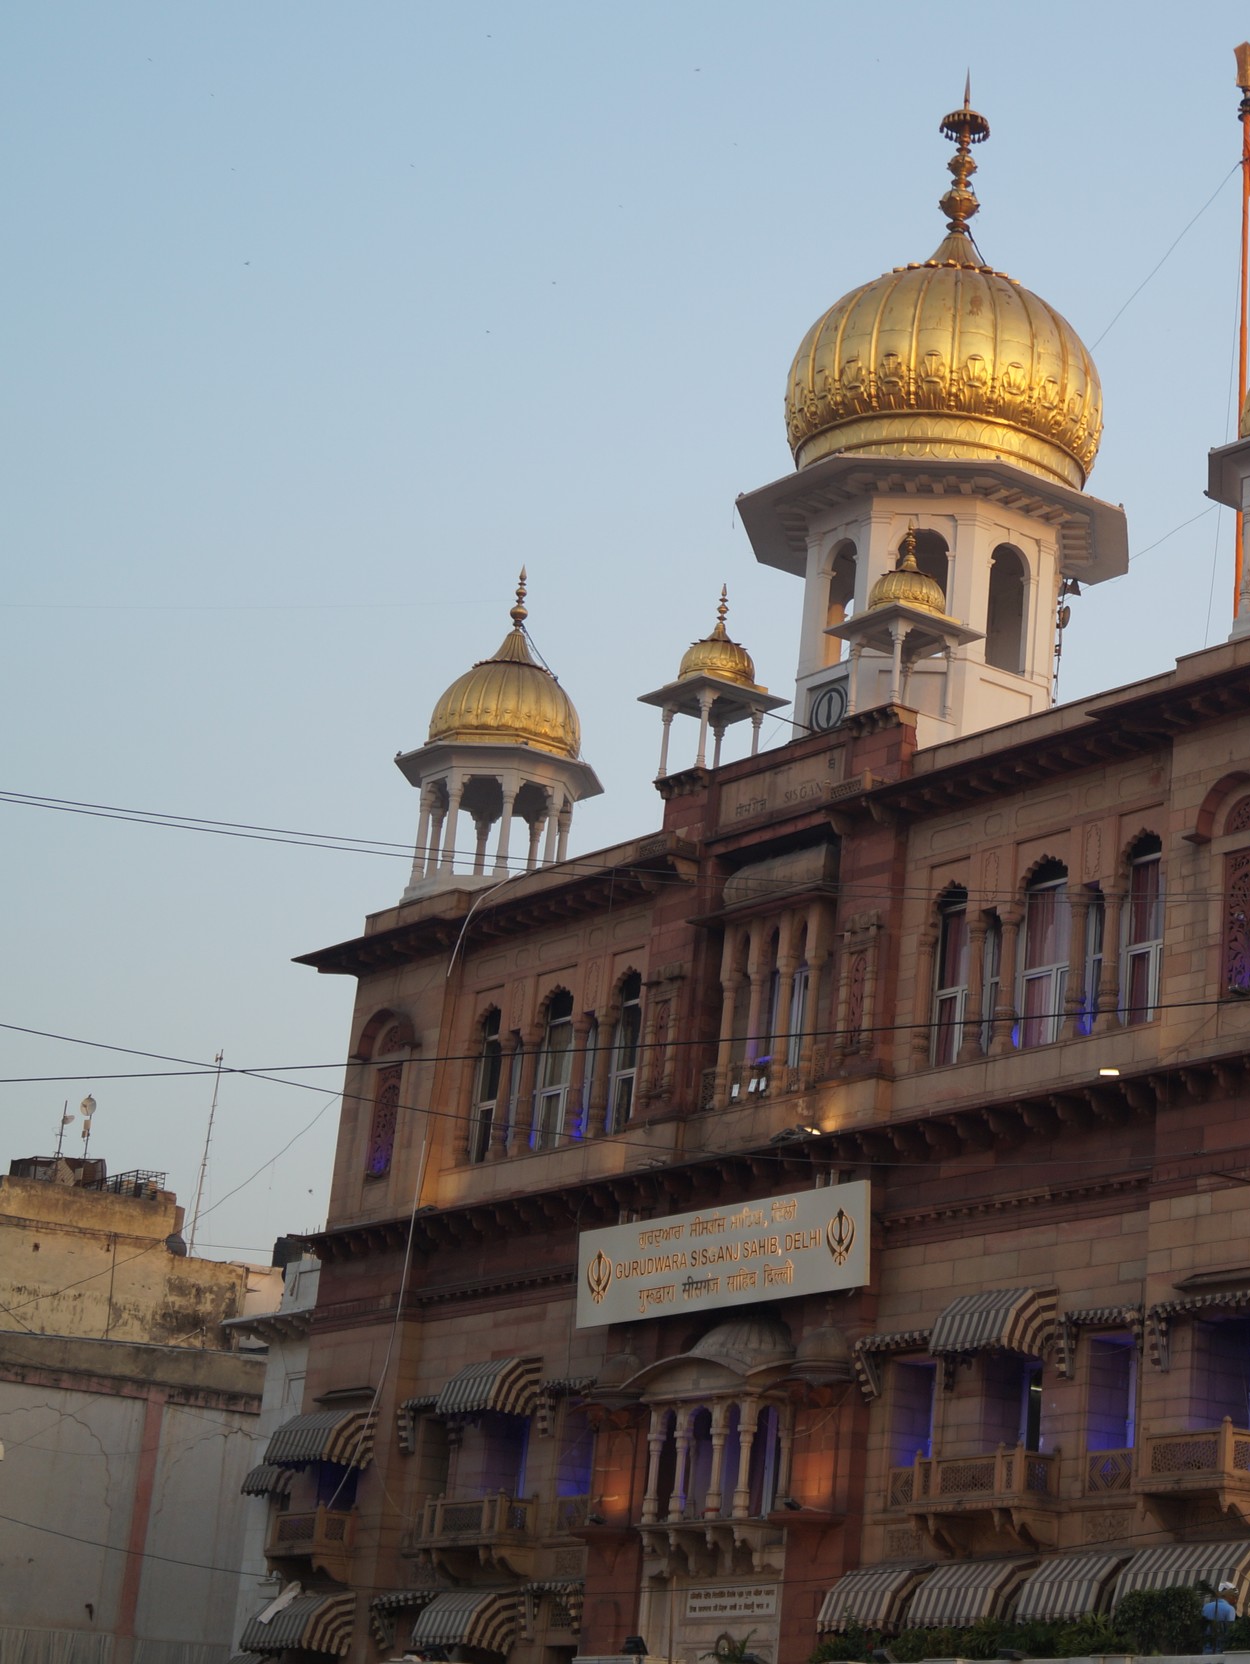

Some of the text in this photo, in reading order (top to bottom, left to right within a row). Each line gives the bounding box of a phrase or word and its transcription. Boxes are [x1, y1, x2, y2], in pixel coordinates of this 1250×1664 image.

[615, 1228, 822, 1280] GURUDWARA SISGANJ SAHIB, DELHI
[682, 1273, 720, 1301] सीसगंज
[763, 1258, 794, 1287] दिल्ली
